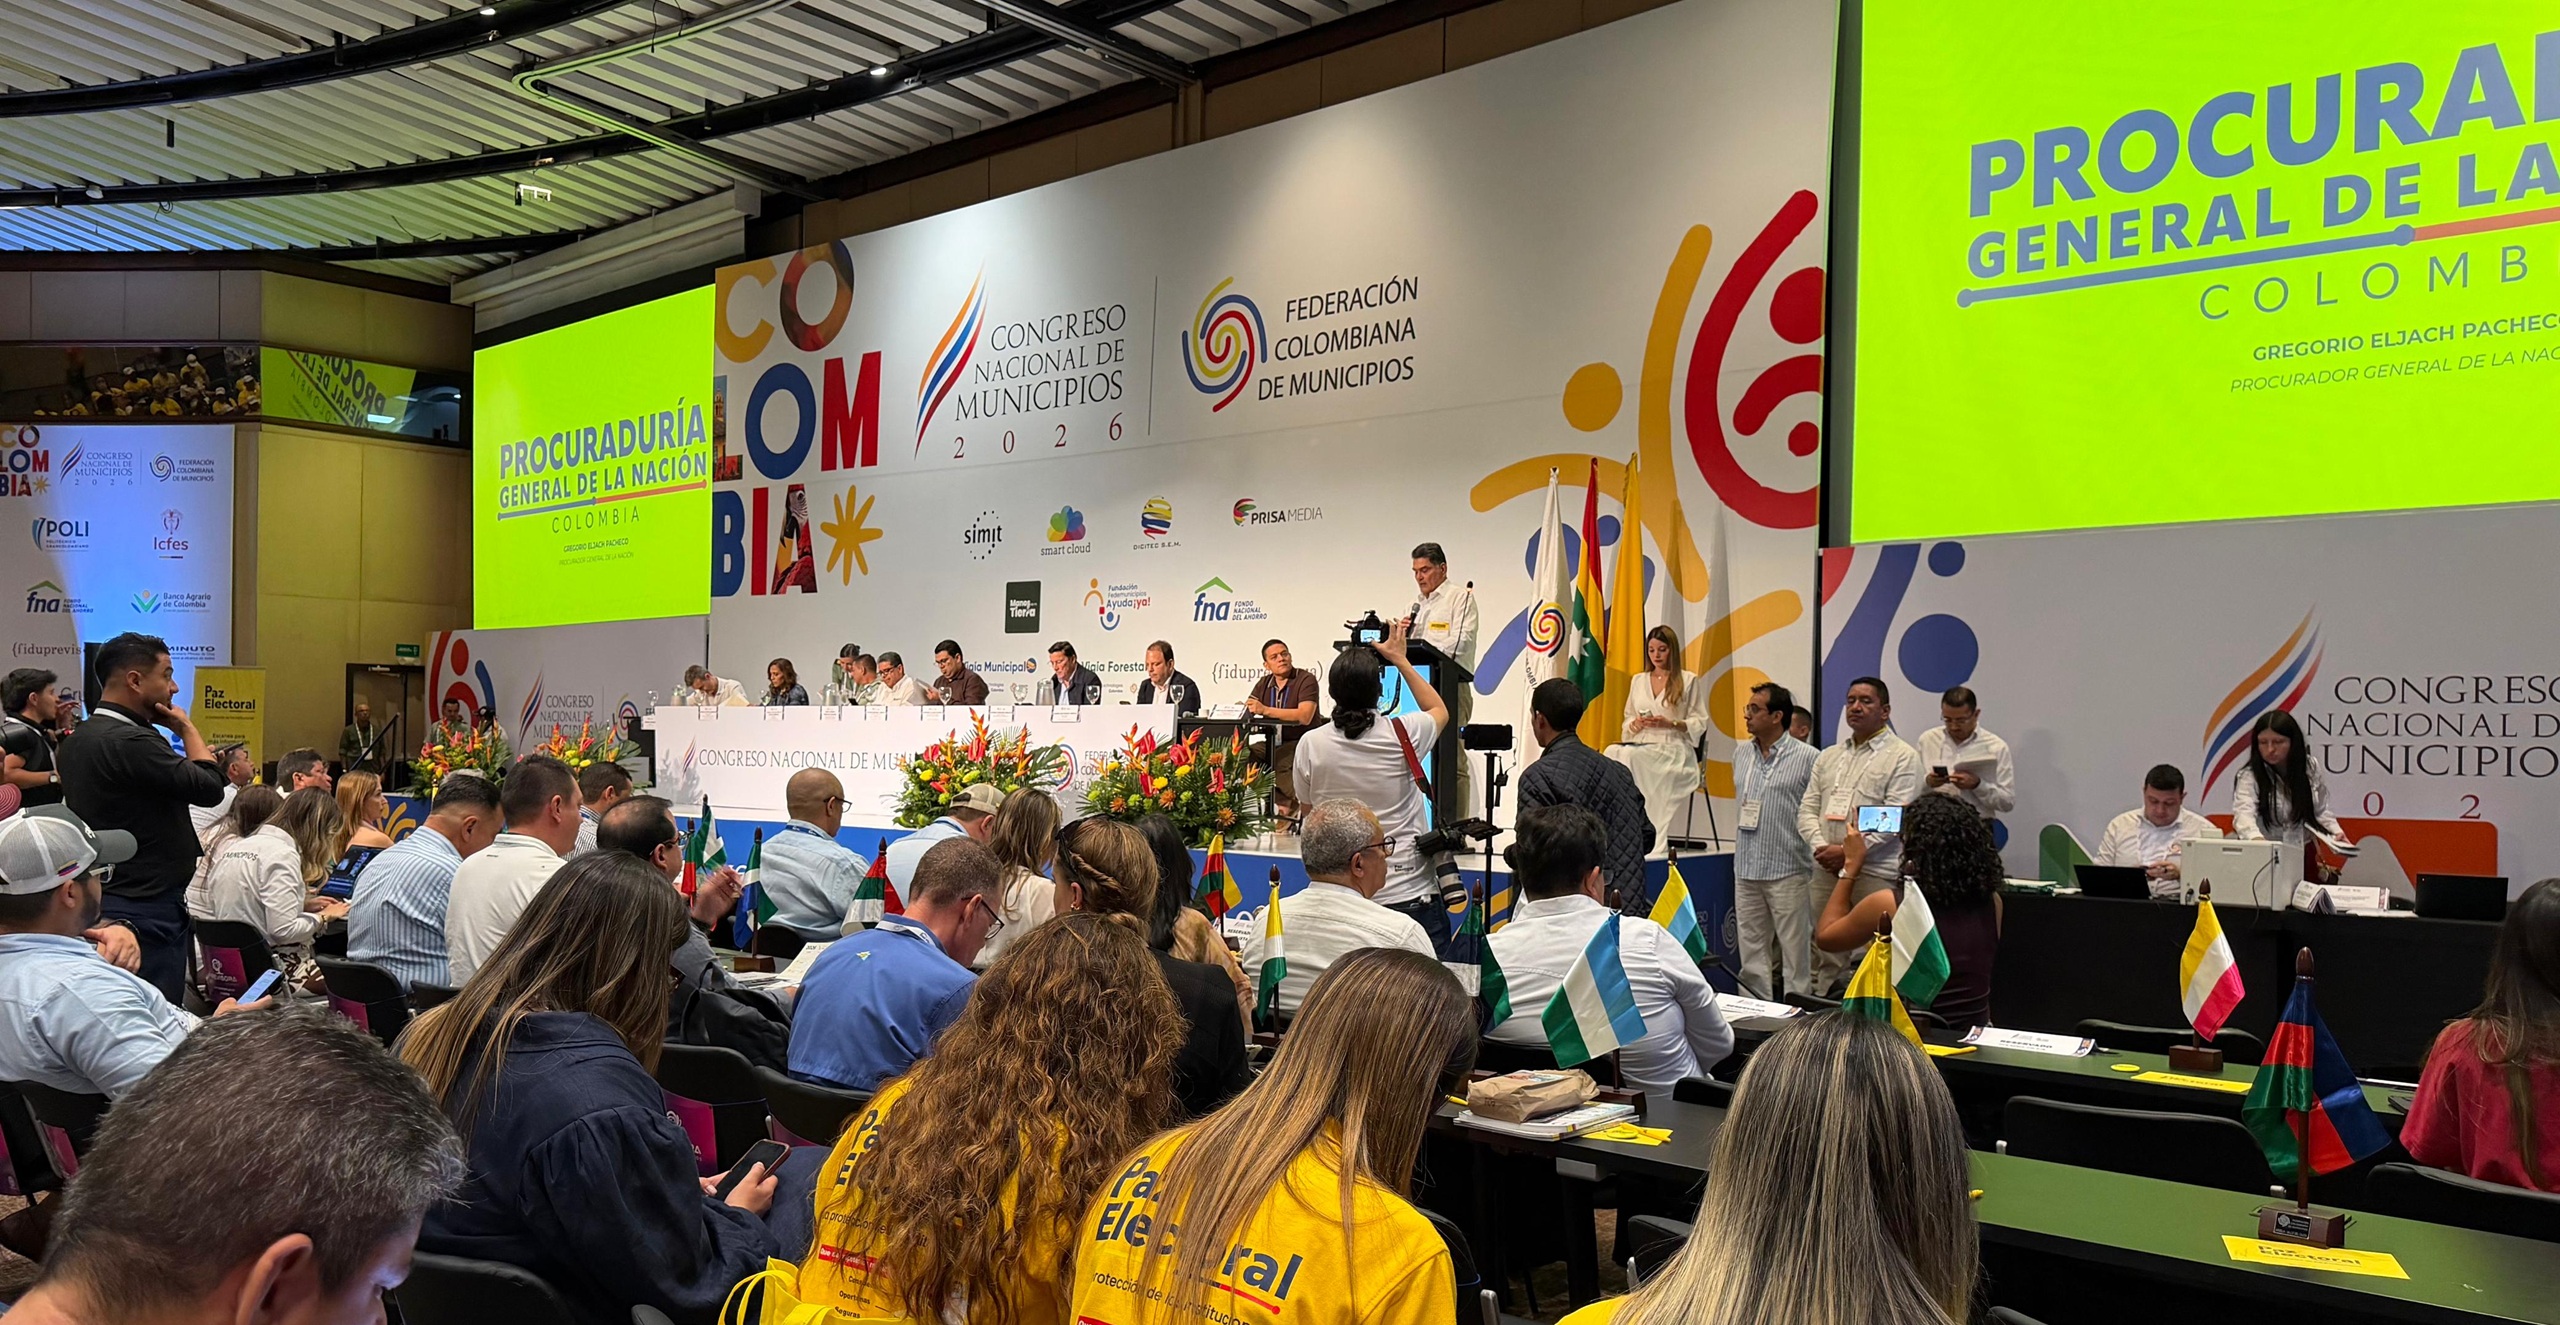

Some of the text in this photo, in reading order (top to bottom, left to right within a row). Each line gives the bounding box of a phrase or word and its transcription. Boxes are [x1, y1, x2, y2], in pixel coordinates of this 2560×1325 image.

[1969, 29, 2560, 218] PROCURA
[1968, 142, 2560, 280] GENERAL DE LA
[2199, 244, 2560, 320] COLOMB
[715, 239, 855, 363] CO
[1286, 275, 1418, 323] FEDERACIÓN
[991, 304, 1126, 351] CONGRESO
[1275, 317, 1416, 361] COLOMBIANA
[2253, 313, 2560, 361] GREGORIO ELJACH PACHEC
[974, 338, 1125, 384] NACIONAL DE
[2230, 346, 2560, 393] PROCURADOR GENERAL DE LA NAC
[1258, 356, 1414, 400] DE MUNICIPIOS
[955, 370, 1123, 422] MUNICIPIOS
[713, 351, 882, 481] LOM
[500, 397, 706, 480] PROCURADURÍA
[81, 460, 132, 468] NACIONAL DE
[86, 452, 133, 460] CONGRESO
[74, 468, 133, 477] MUNICIPIOS
[500, 449, 707, 509] GENERAL DE LA NACIÓN
[46, 520, 89, 537] POLI
[552, 505, 640, 534] COLOMBIA
[154, 537, 189, 551] Icfes
[711, 484, 818, 597] BIA
[964, 524, 1002, 545] simit
[1041, 542, 1091, 556] smart cloud
[186, 593, 212, 602] Agrario
[1108, 583, 1138, 591] Fundación
[26, 592, 61, 613] fna
[1010, 608, 1036, 618] Tierra
[1194, 592, 1231, 622] fna
[12, 642, 82, 658] {fiduprevis
[984, 660, 1027, 675] Municipal
[204, 699, 256, 710] Electoral
[205, 685, 225, 699] Paz
[545, 695, 595, 708] CONGRESO
[540, 710, 583, 721] NACIONAL
[2307, 712, 2560, 738] NACIONAL D
[699, 749, 767, 767] CONGRESO
[770, 751, 845, 769] NACIONAL
[850, 752, 868, 769] DE
[2322, 744, 2560, 779] UNICIPIO
[850, 1109, 882, 1150] Pa
[1110, 1155, 1161, 1203] Pa
[1095, 1201, 1304, 1301] Elecral
[2260, 1251, 2362, 1265] Electoral
[1147, 1286, 1163, 1302] de
